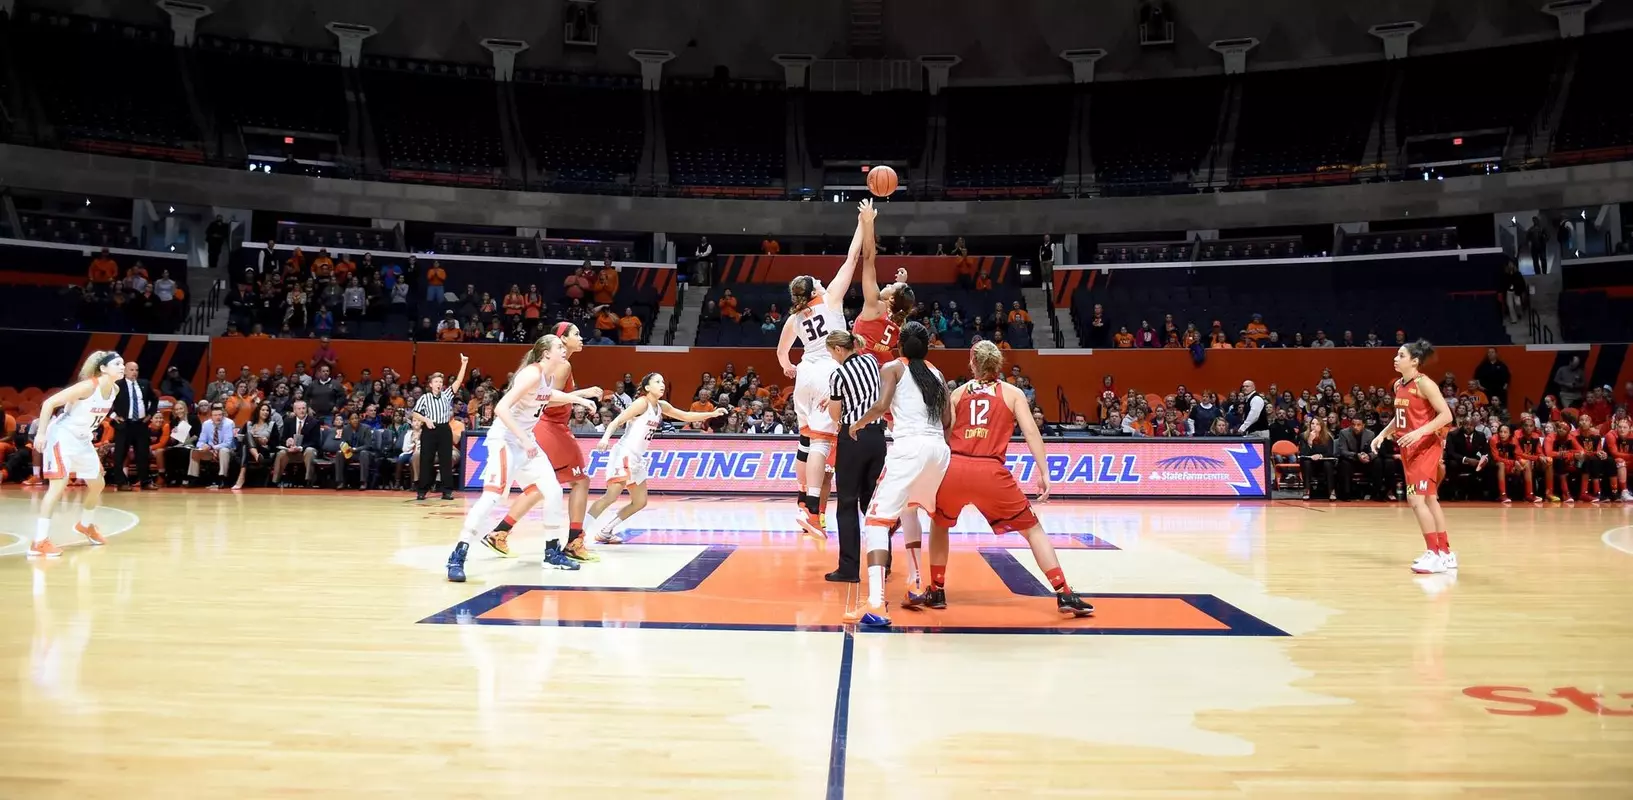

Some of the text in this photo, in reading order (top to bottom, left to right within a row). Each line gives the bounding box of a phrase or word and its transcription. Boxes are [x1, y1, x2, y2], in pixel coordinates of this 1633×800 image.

[802, 314, 829, 342] 32
[880, 324, 895, 346] 5
[969, 399, 990, 426] 12
[1396, 408, 1406, 428] 15
[572, 467, 581, 477] M
[587, 451, 797, 479] FHTING IL
[1419, 480, 1428, 491] M
